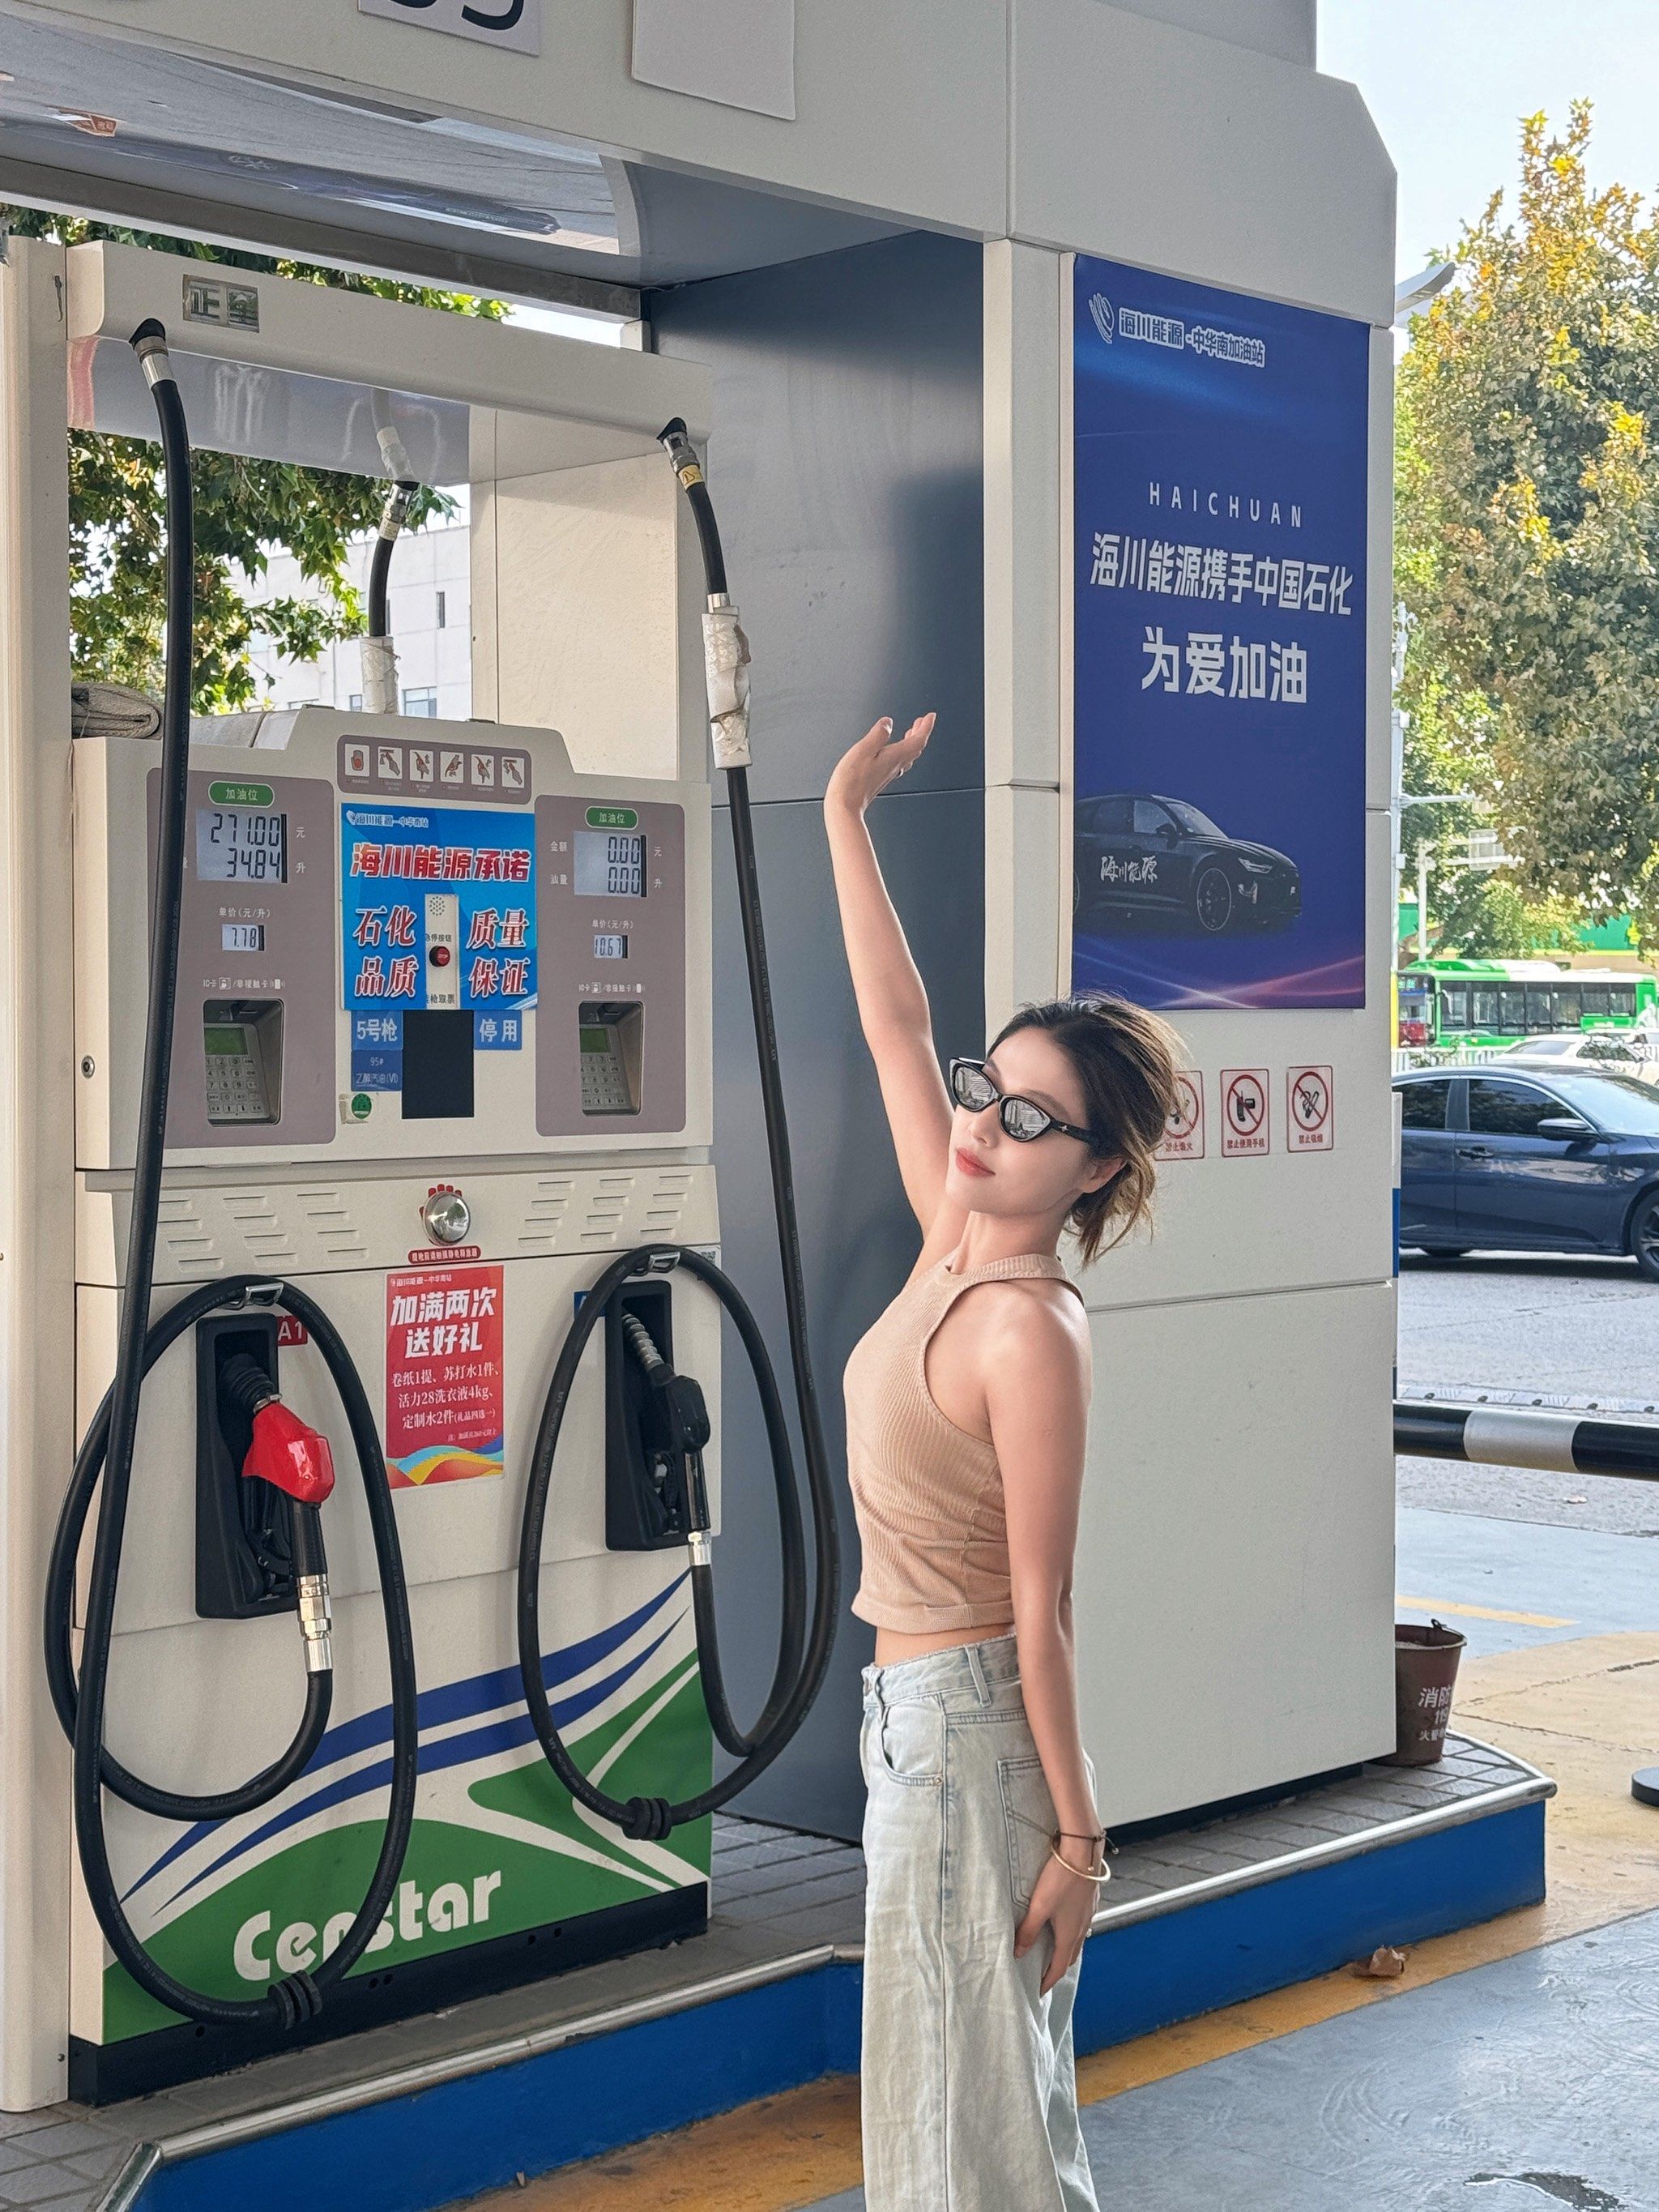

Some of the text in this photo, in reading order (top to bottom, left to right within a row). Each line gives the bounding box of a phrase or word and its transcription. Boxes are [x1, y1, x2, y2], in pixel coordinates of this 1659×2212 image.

[1149, 482, 1303, 528] HAICHUAN
[1090, 532, 1354, 616] 海川能源携手中国石化
[1141, 626, 1308, 704] 为爱加油
[225, 788, 258, 801] 加油位
[211, 813, 280, 847] 271.00
[599, 813, 625, 823] 加油位
[296, 827, 305, 839] 元
[550, 841, 567, 852] 金额
[608, 836, 640, 865] 0.00
[654, 848, 662, 856] 元
[227, 848, 280, 879] 34.84
[296, 863, 305, 873] 升
[350, 842, 531, 882] 海川能源承诺
[608, 866, 640, 894] 0.00
[654, 878, 663, 889] 升
[352, 904, 529, 950] 石化 质量
[354, 954, 530, 998] 品质 保证
[427, 994, 455, 1004] 枪取票
[356, 1018, 398, 1042] 5号枪
[480, 1018, 518, 1043] 停用
[1226, 1138, 1265, 1149] 禁止使用手机
[390, 1287, 497, 1326] 加满两次
[278, 1321, 302, 1341] A1
[405, 1321, 483, 1358] 送好礼
